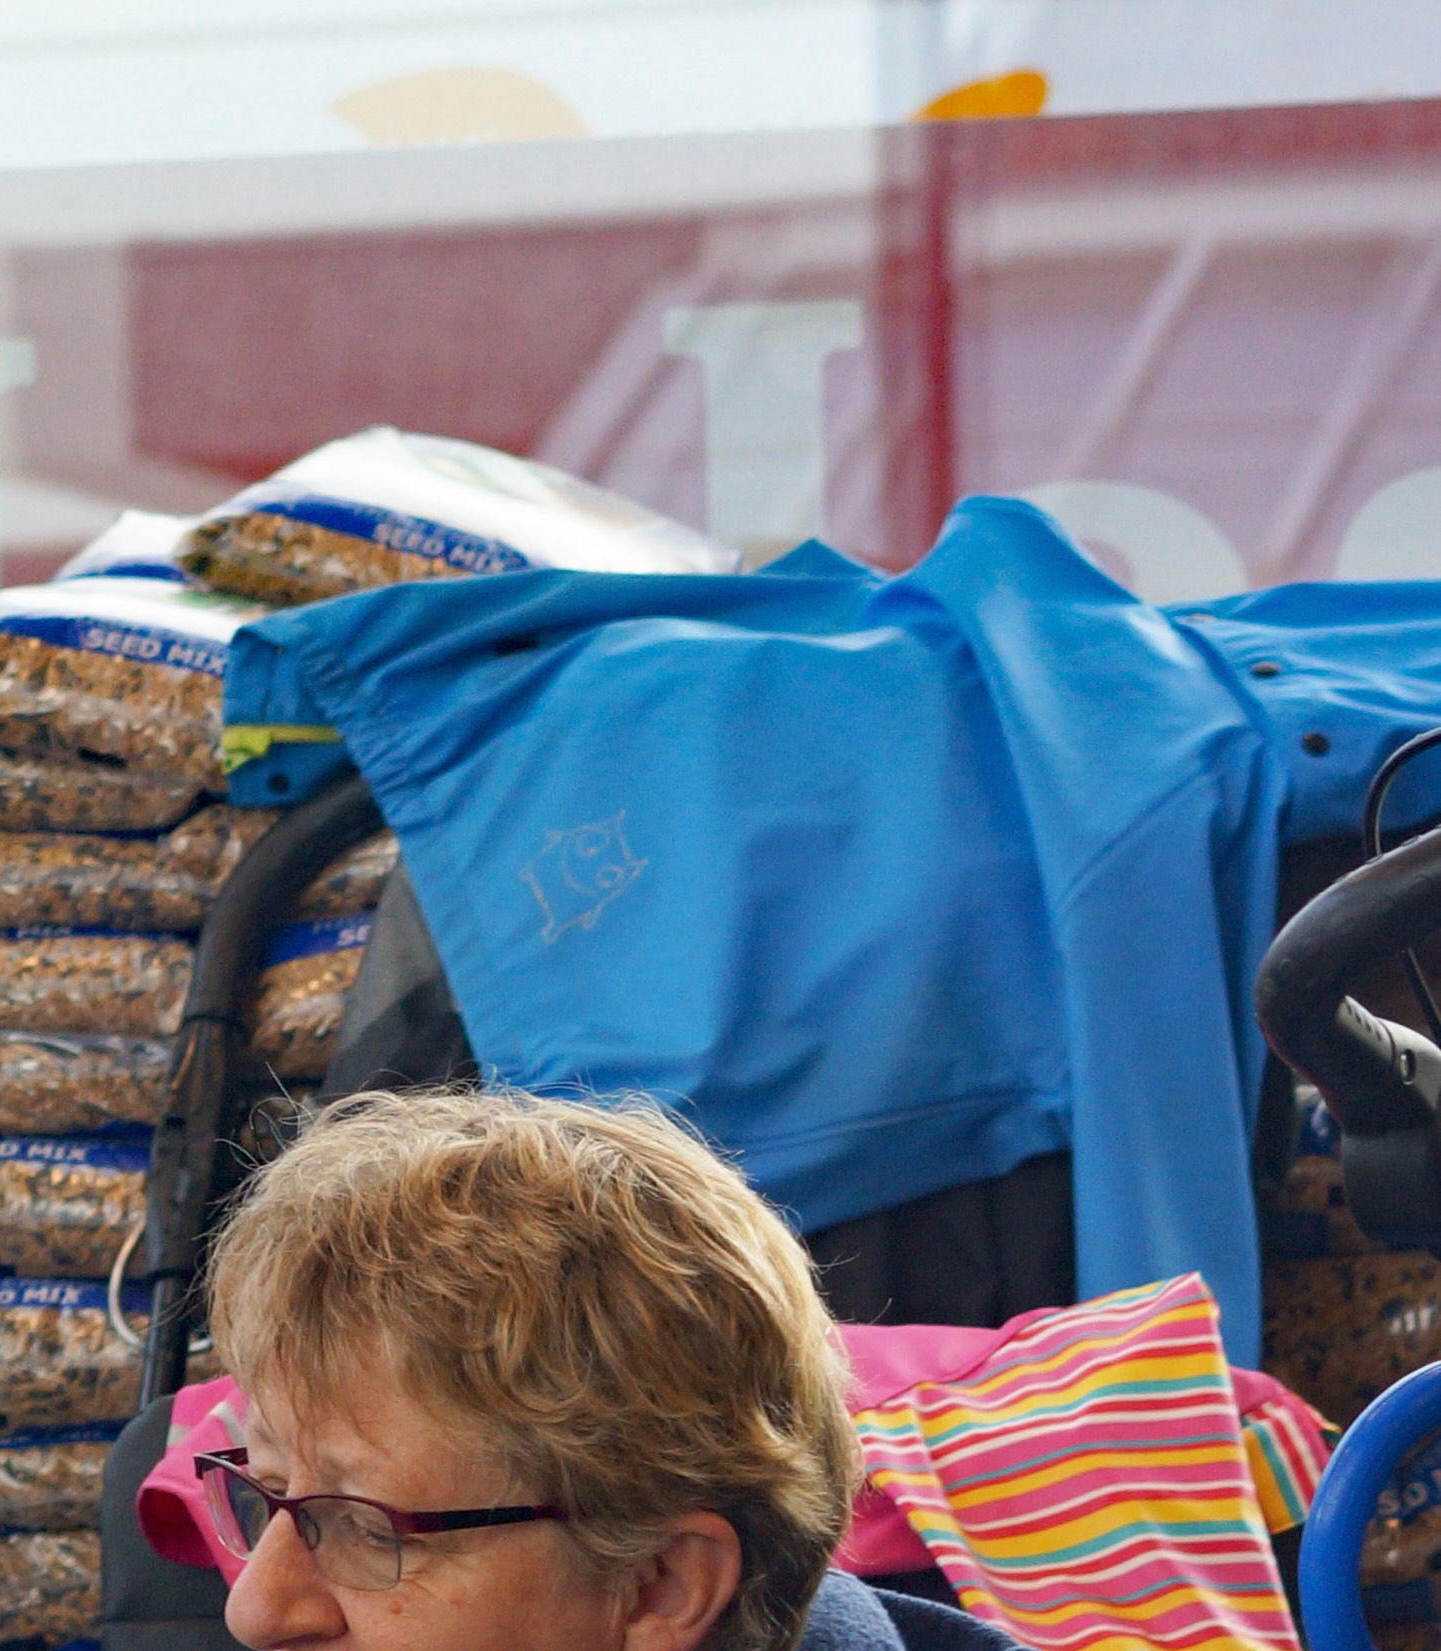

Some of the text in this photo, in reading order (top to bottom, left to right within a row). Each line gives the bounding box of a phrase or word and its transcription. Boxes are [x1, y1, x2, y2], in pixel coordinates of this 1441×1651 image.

[373, 522, 446, 557] SEED
[86, 628, 228, 674] SEED MIX
[26, 1144, 87, 1161] MIX
[22, 1285, 82, 1306] MIX
